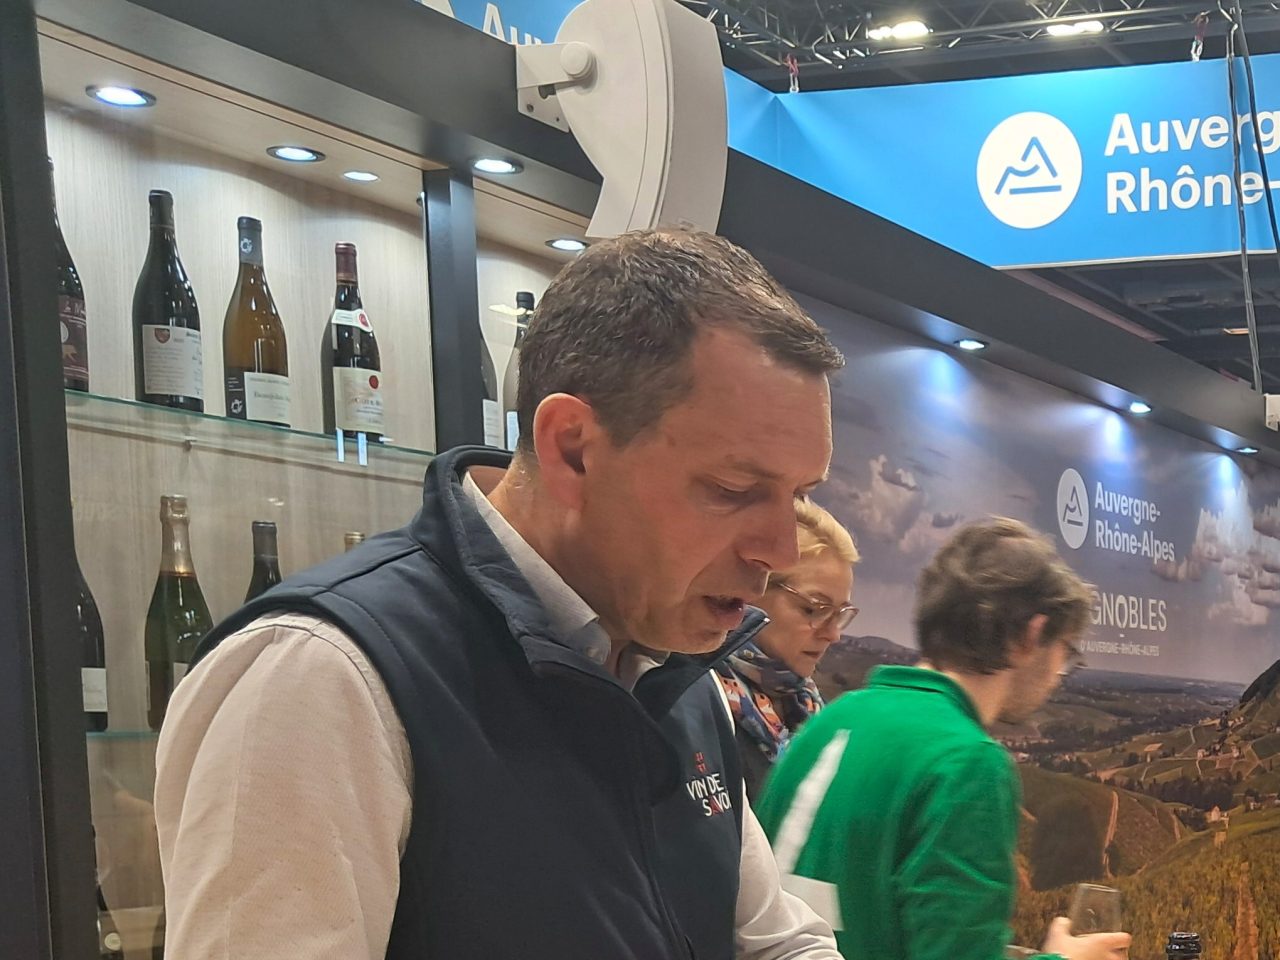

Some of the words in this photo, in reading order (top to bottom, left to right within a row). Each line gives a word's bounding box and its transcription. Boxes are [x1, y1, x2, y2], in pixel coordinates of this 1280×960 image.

[1095, 481, 1160, 525] Auvergne-
[1096, 520, 1175, 564] Rhône-Alpes
[1090, 590, 1167, 632] GNOBLES
[686, 778, 709, 801] VIN
[706, 773, 724, 794] DE
[702, 790, 732, 816] SAVOI
